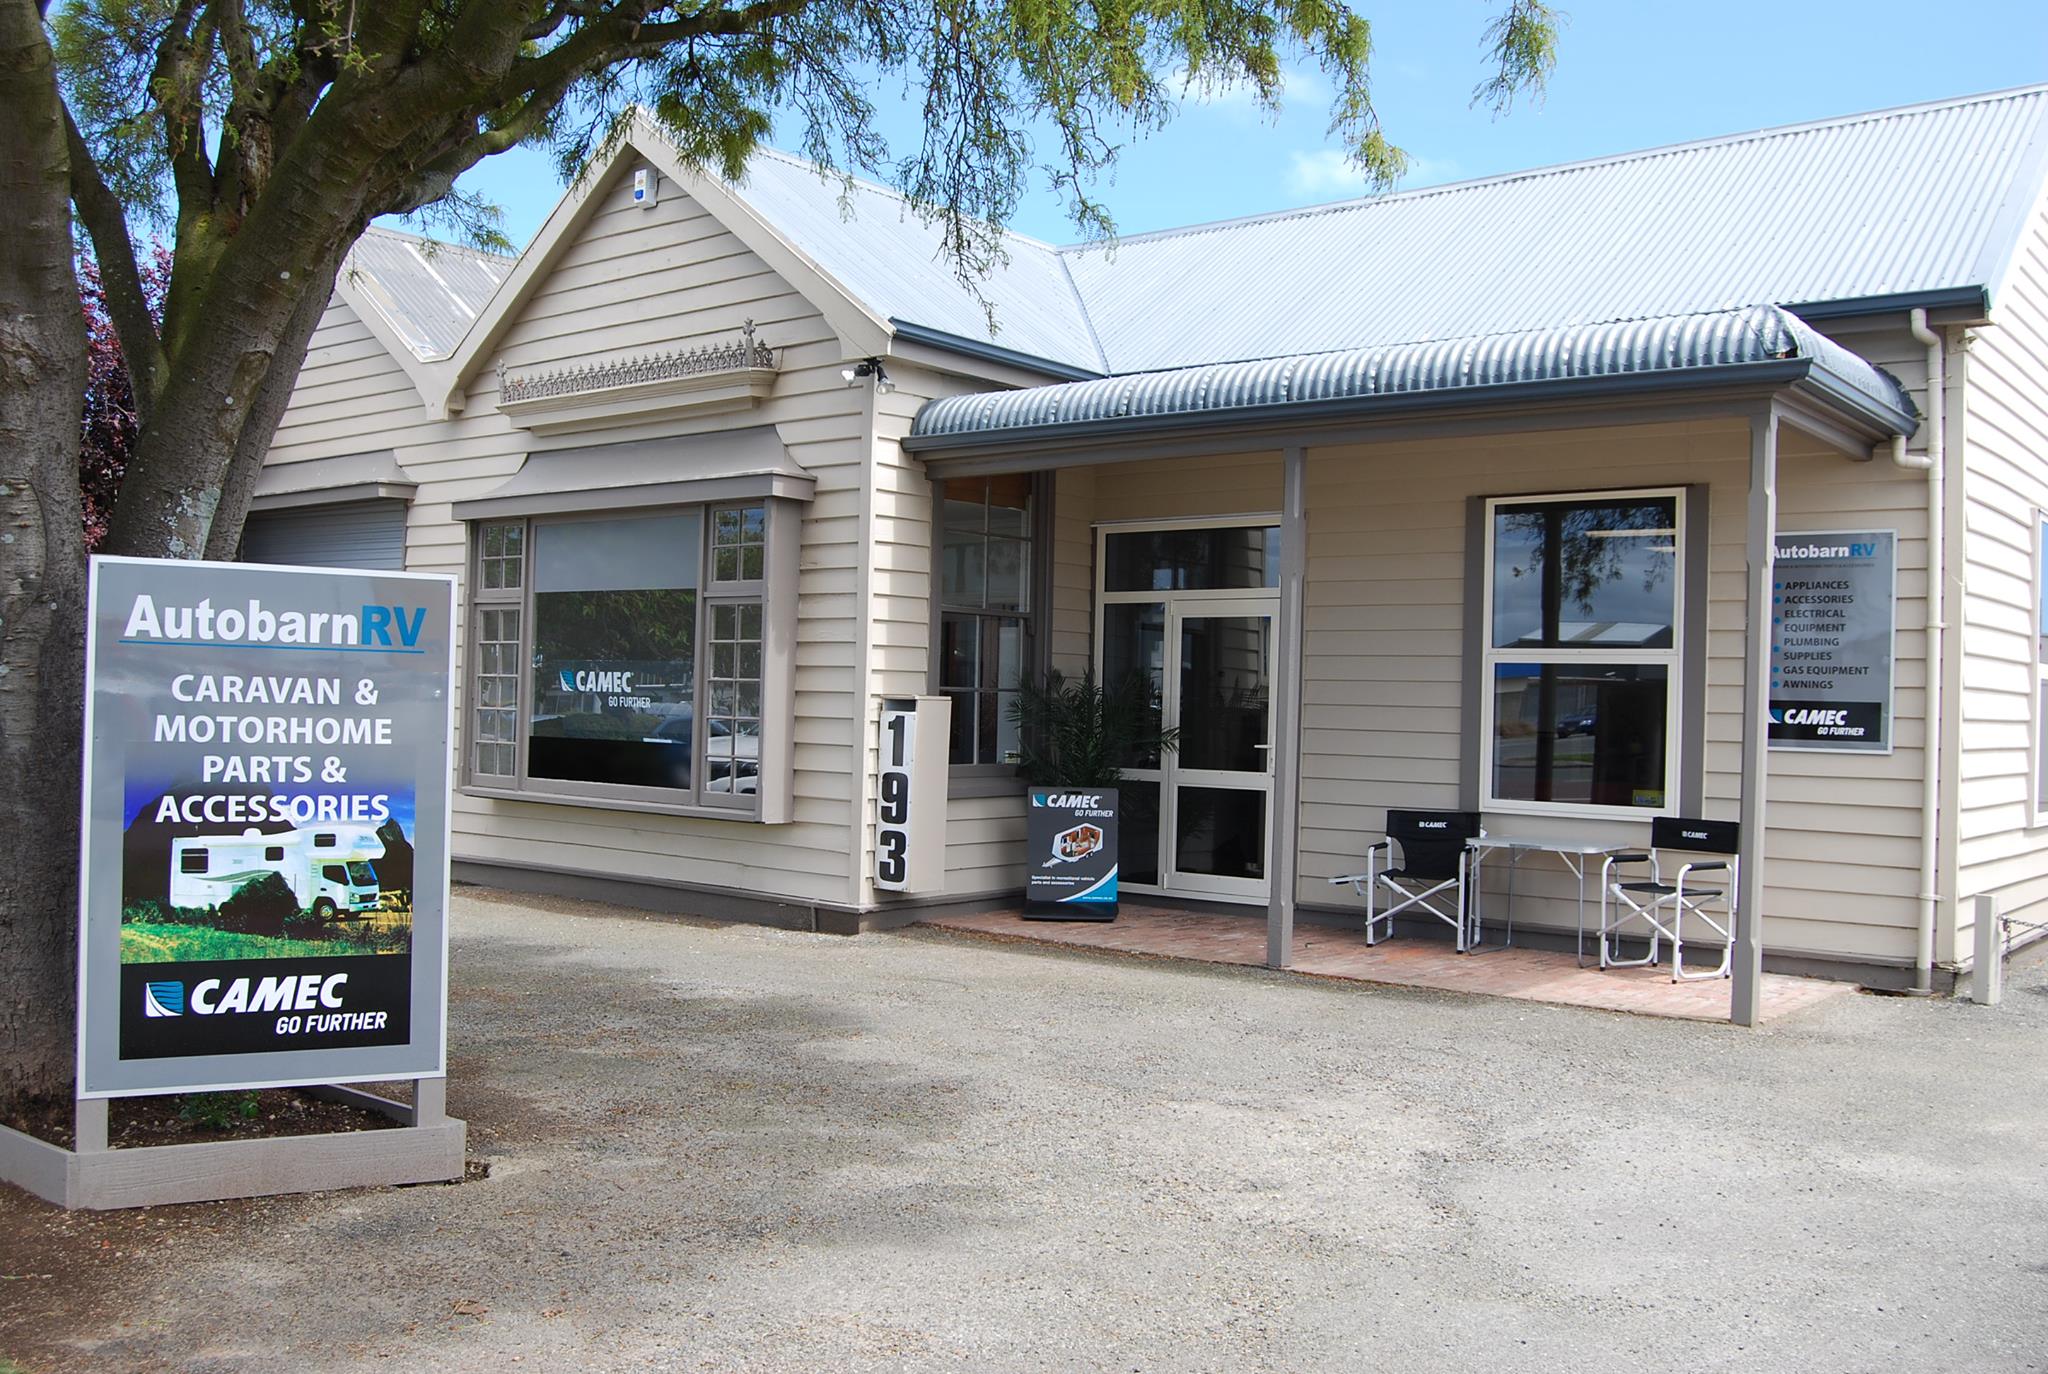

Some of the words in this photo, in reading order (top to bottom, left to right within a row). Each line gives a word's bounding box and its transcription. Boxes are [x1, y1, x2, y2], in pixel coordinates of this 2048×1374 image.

[1784, 580, 1850, 590] APPLIANCES
[1784, 594, 1854, 604] ACCESSORIES
[1784, 609, 1846, 618] ELECTRICAL
[124, 594, 428, 647] AutobarnRV
[1784, 623, 1847, 633] EQUIPMENT
[1783, 637, 1840, 647] PLUMBING
[1783, 651, 1832, 661] SUPPLIES
[1782, 666, 1804, 675] GAS
[1806, 666, 1869, 676] EQUIPMENT
[576, 670, 632, 693] CAMEC
[1782, 680, 1834, 690] AWNINGS
[171, 674, 341, 705] CARAVAN
[354, 678, 379, 705] &
[608, 696, 618, 707] GO
[619, 696, 651, 709] FURTHER
[1783, 709, 1848, 726] CAMEC
[154, 714, 393, 745] MOTORHOME
[1817, 727, 1829, 736] GO
[1829, 727, 1865, 737] FURTHER
[202, 755, 313, 784] PARTS
[320, 756, 347, 784] &
[1047, 794, 1100, 808] CAMEC
[154, 794, 390, 824] ACCESSORIES
[1074, 809, 1083, 817] GO
[1084, 810, 1114, 818] FURTHER
[1688, 831, 1707, 839] CAMEC
[190, 973, 348, 1016] CAMEC
[275, 1015, 301, 1036] GO
[305, 1011, 388, 1034] FURTHER
